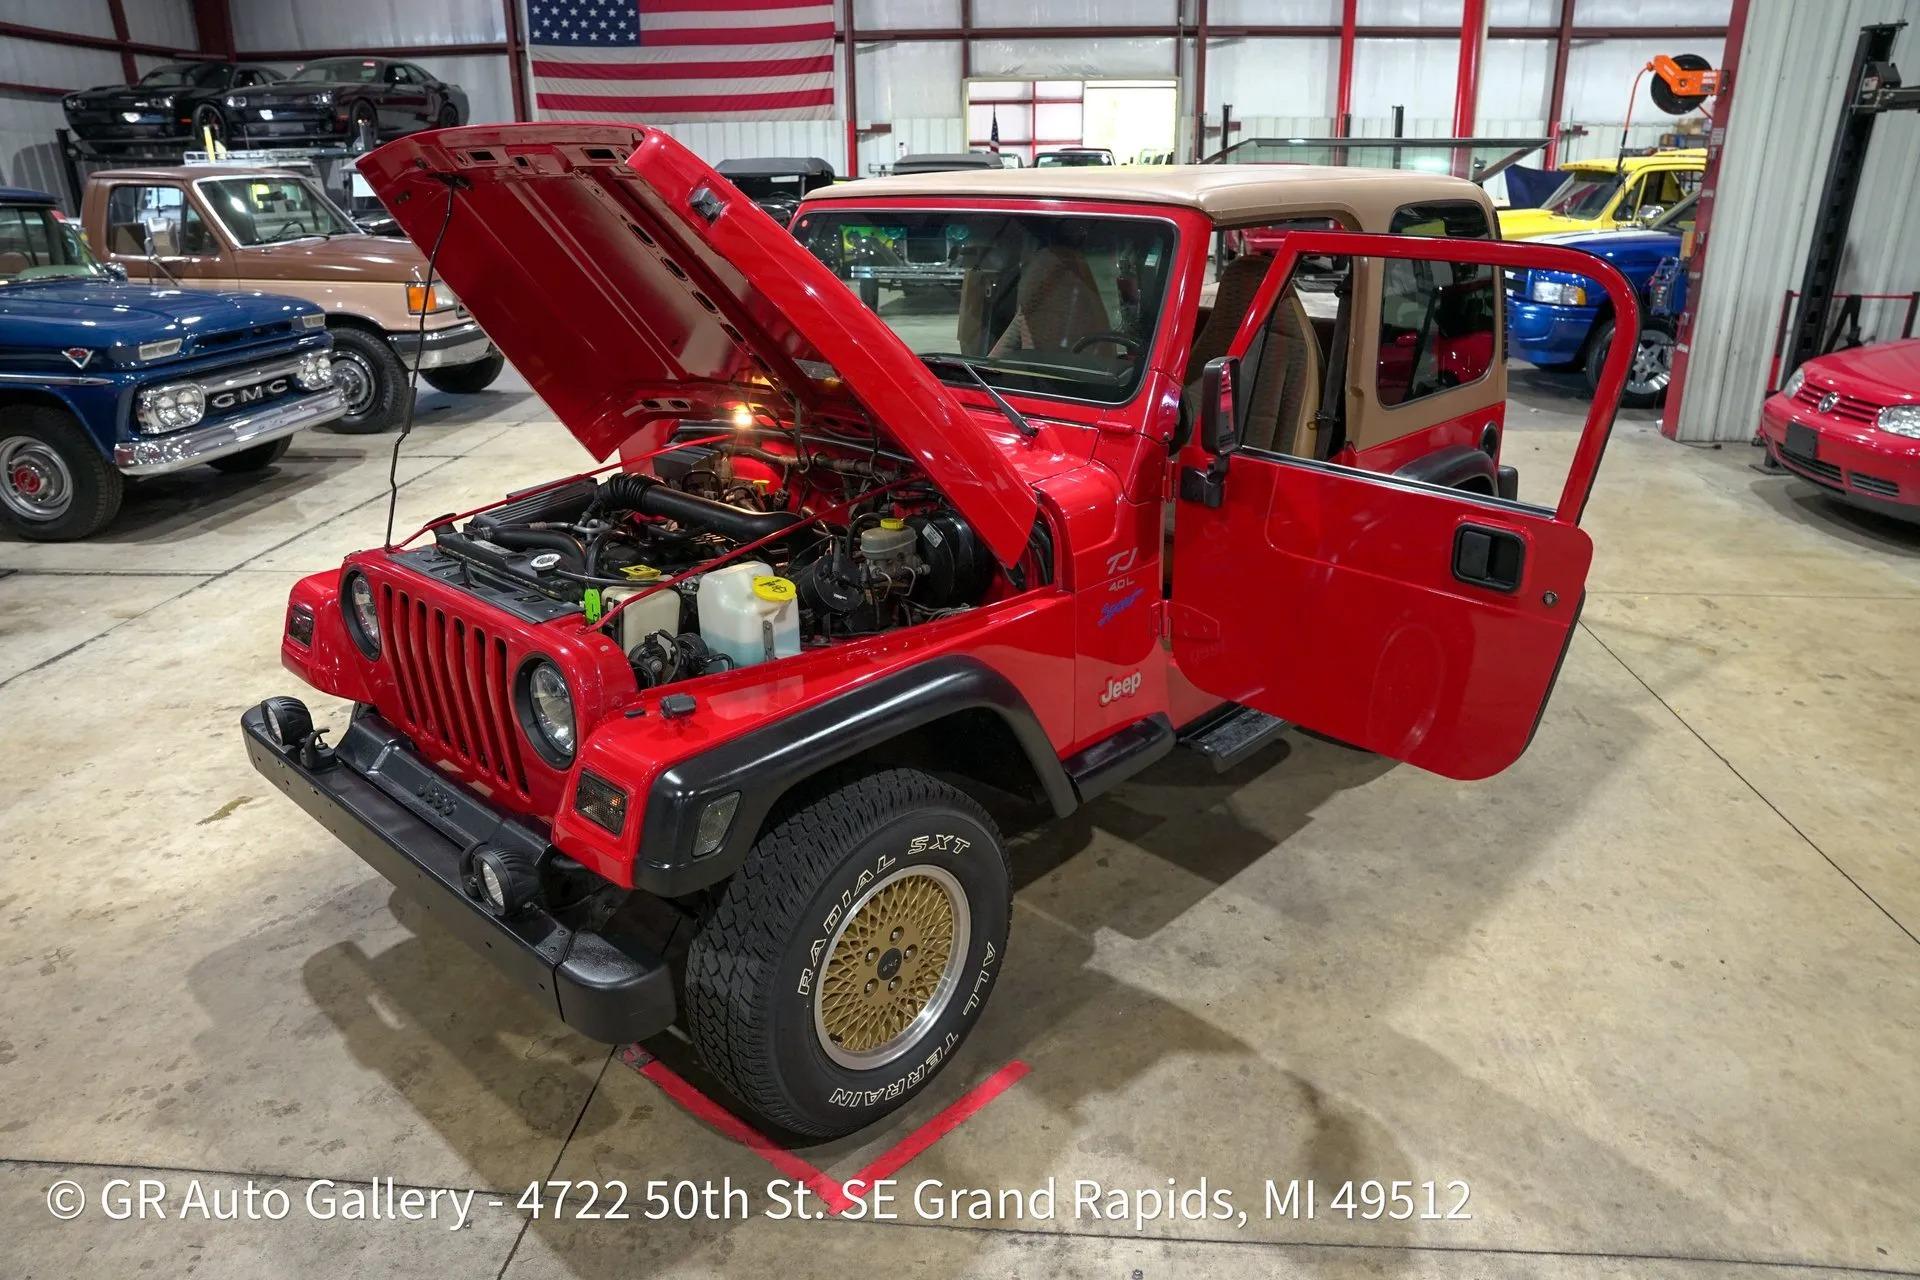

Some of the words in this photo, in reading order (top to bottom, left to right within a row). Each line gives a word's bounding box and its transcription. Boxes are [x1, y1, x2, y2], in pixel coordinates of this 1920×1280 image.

[211, 379, 289, 408] GMC
[1106, 546, 1139, 575] TJ
[1101, 671, 1142, 704] Jeep
[797, 854, 896, 996] RADIAL
[907, 834, 971, 855] SXT
[962, 940, 997, 1016] ALL
[828, 1032, 959, 1108] TERRAIN
